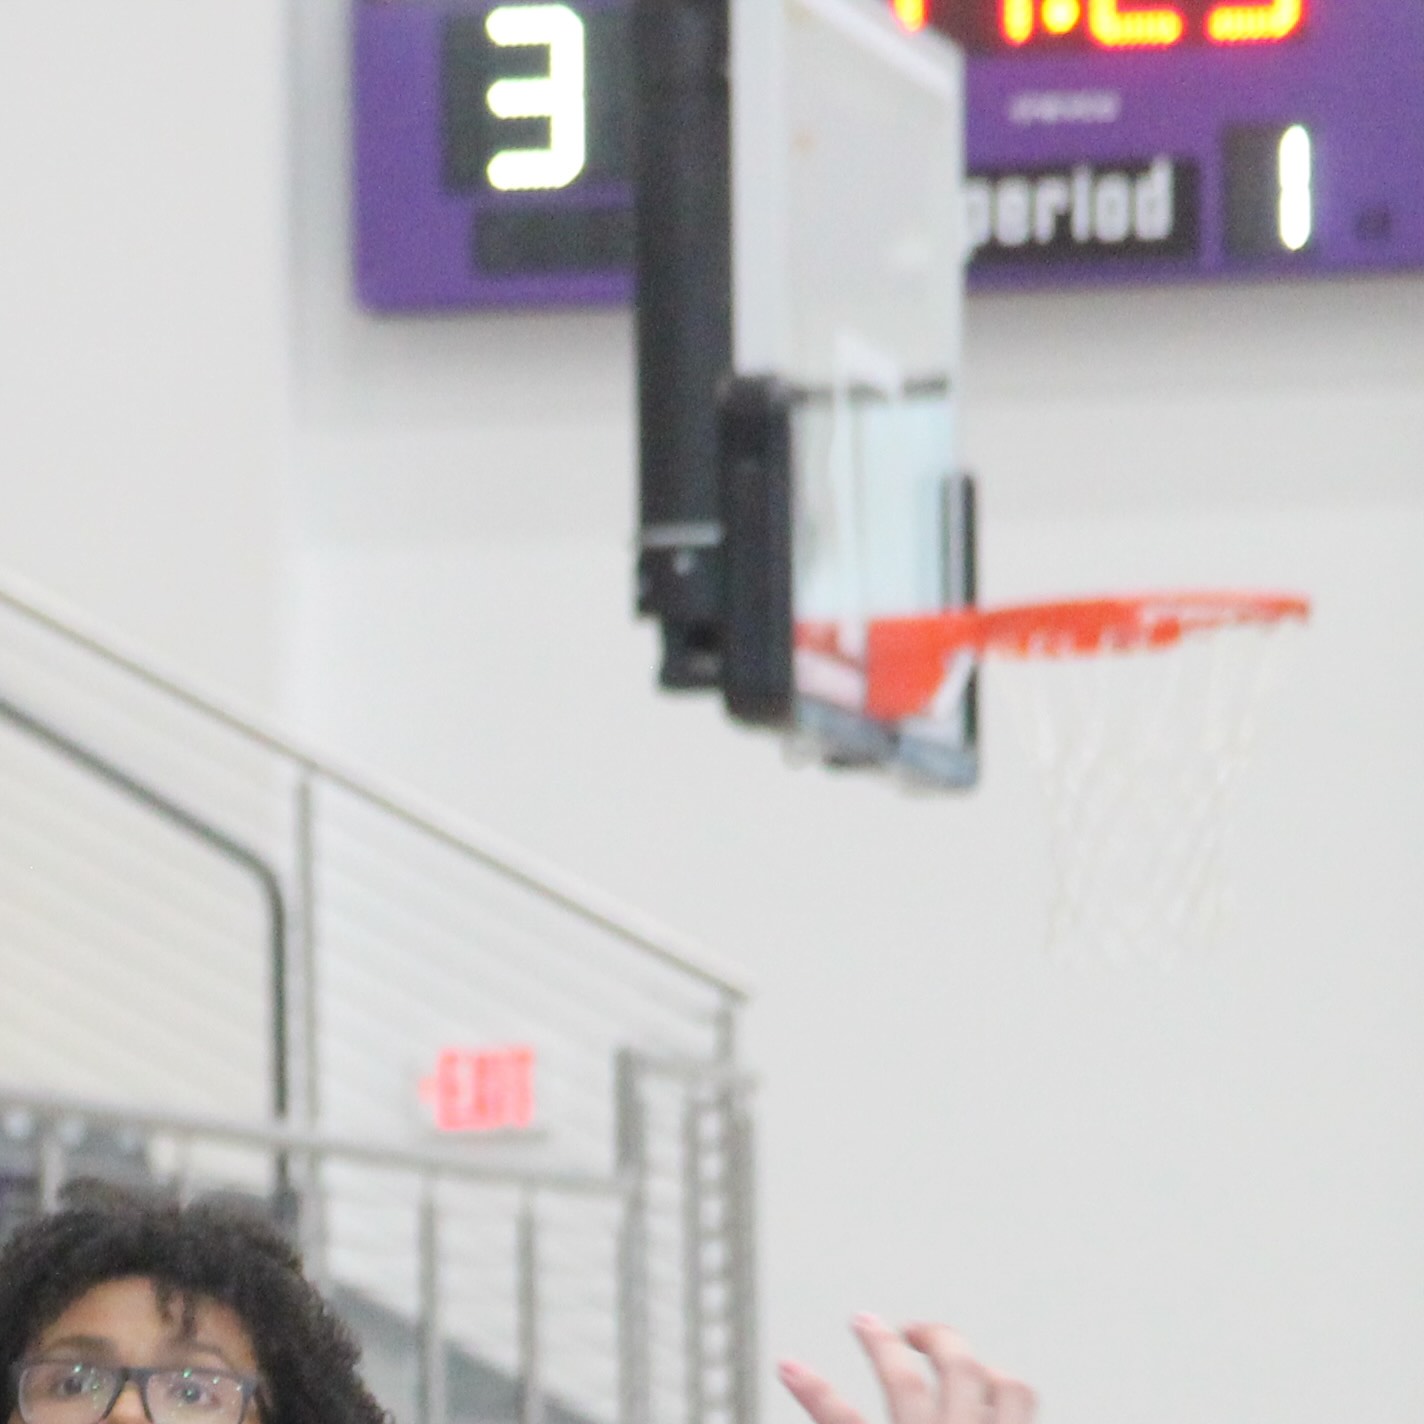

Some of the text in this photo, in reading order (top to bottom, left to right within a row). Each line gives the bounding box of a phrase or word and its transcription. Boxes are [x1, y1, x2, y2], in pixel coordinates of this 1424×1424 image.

[484, 4, 587, 192] 3
[964, 156, 1176, 262] period
[1277, 123, 1314, 252] 1
